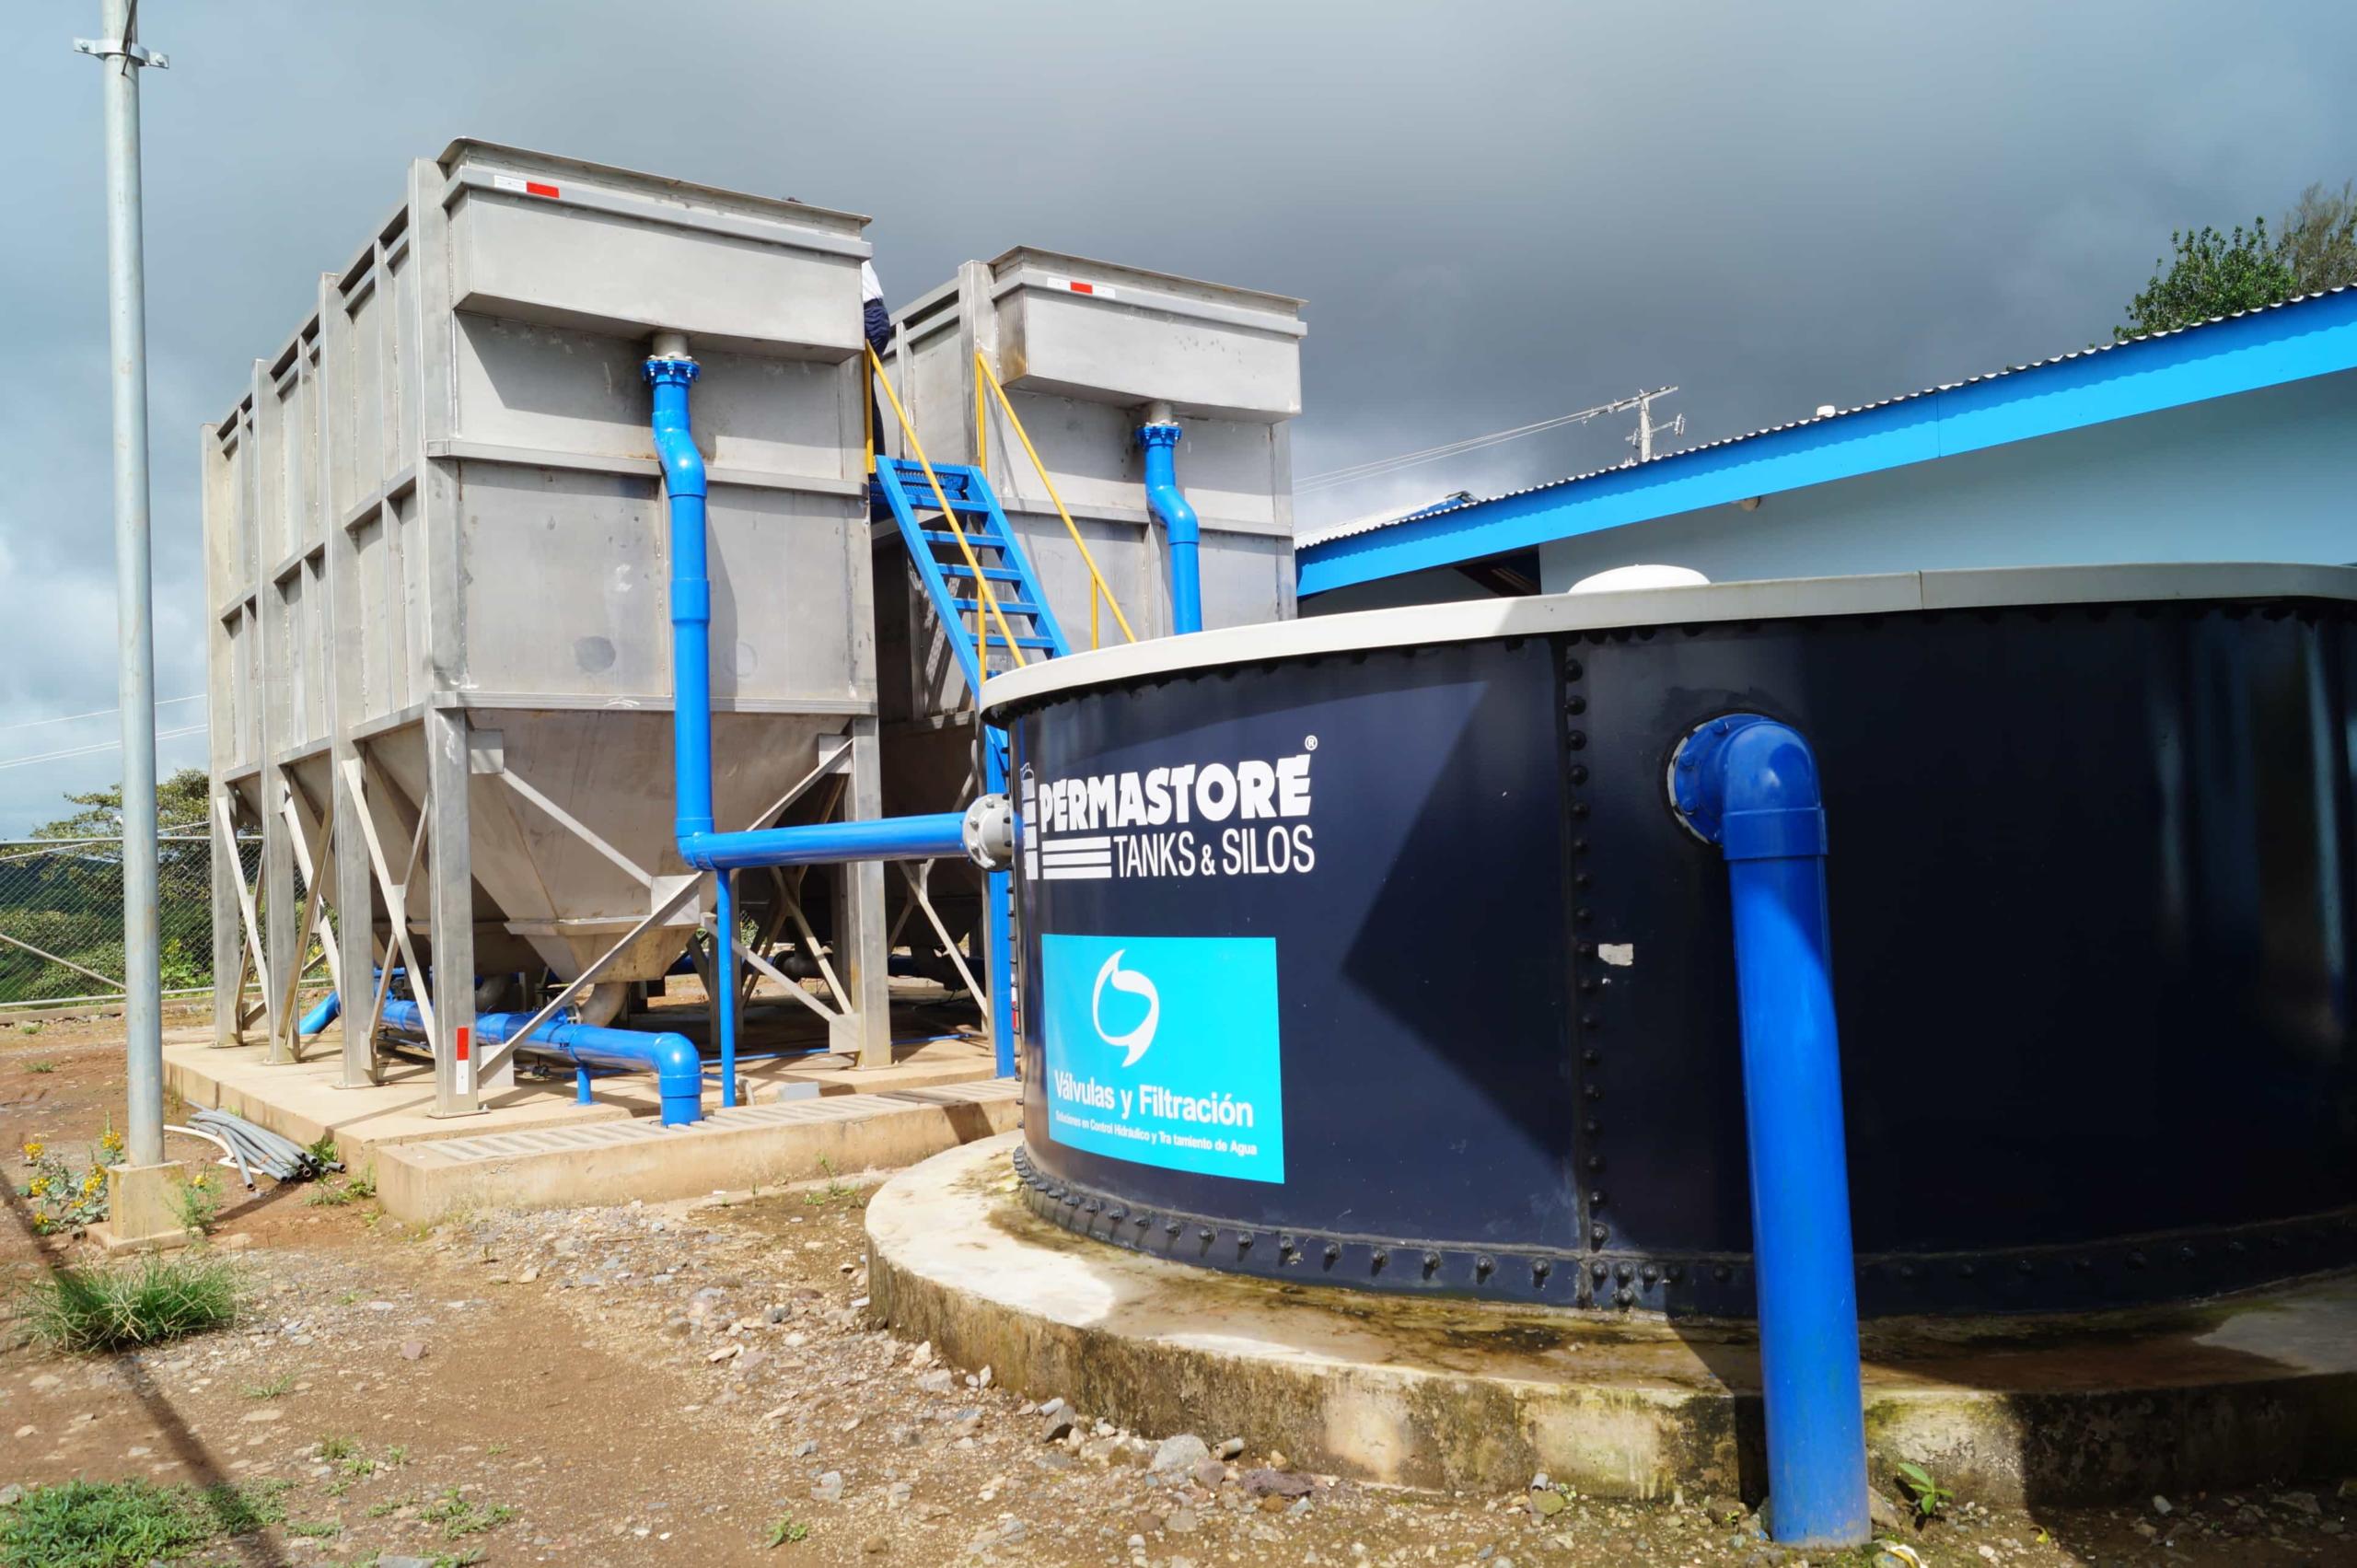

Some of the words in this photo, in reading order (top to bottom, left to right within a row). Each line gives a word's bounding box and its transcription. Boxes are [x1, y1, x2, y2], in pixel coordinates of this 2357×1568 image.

[1039, 753, 1311, 833] PERMASTORE
[1113, 830, 1196, 878] TANKS
[1201, 843, 1216, 876] &
[1222, 825, 1316, 876] SILOS
[1053, 1069, 1115, 1110] Válvulas
[1120, 1088, 1133, 1121] y
[1138, 1084, 1255, 1128] Filtración
[1090, 1119, 1113, 1134] Control
[1151, 1132, 1157, 1145] y
[1214, 1138, 1228, 1152] de
[1230, 1140, 1258, 1156] Agua
